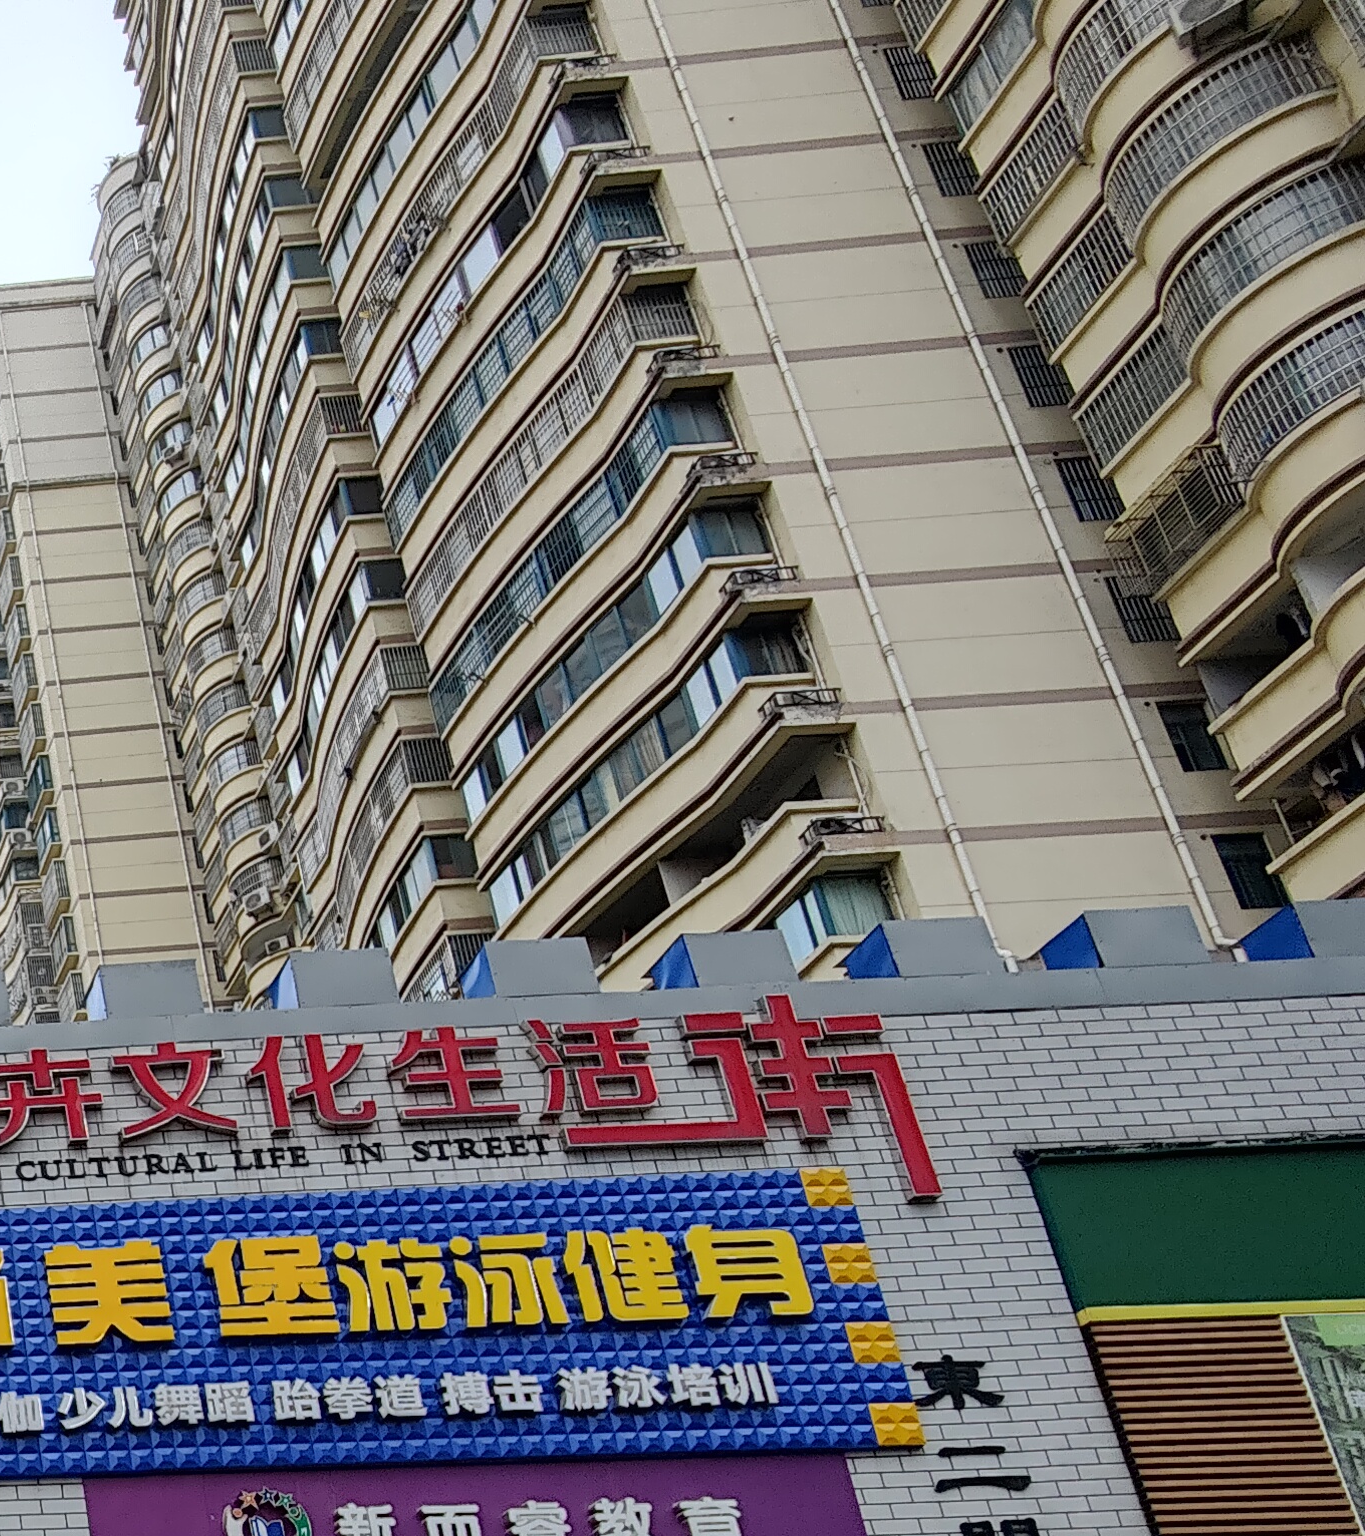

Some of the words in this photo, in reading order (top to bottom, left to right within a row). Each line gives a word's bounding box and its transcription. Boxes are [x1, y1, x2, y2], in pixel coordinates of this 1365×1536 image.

[15, 1149, 219, 1184] CULTURAL
[233, 1145, 310, 1174] LIFE
[343, 1141, 383, 1165] IN
[412, 1132, 551, 1163] STREET
[57, 1370, 255, 1430] 少儿舞蹈
[273, 1371, 429, 1423] 跆拳道
[439, 1368, 546, 1418] 搏击
[556, 1360, 781, 1414] 游泳培训
